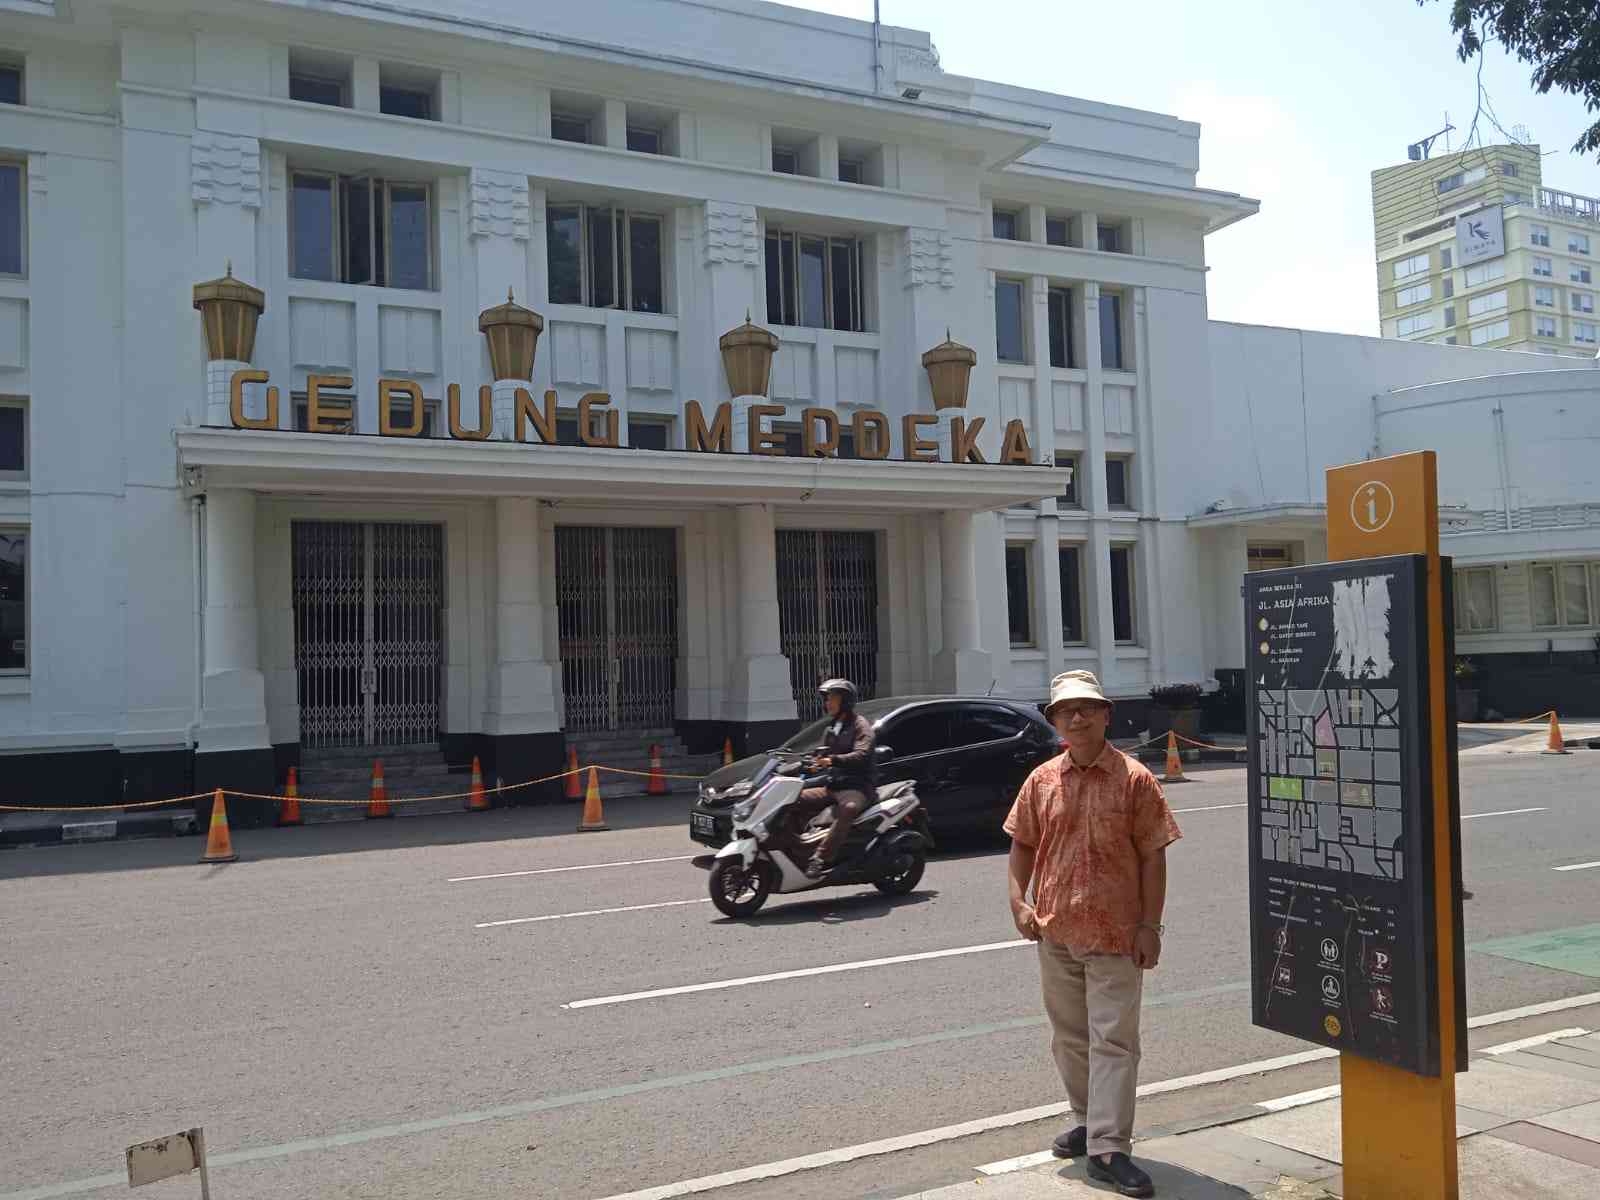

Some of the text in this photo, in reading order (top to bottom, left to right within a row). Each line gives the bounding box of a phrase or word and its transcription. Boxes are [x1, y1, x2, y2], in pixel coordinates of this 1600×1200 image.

[230, 370, 1033, 464] GEDUNG MERDEKA
[1258, 595, 1330, 610] JL. ASIA AFRIKA
